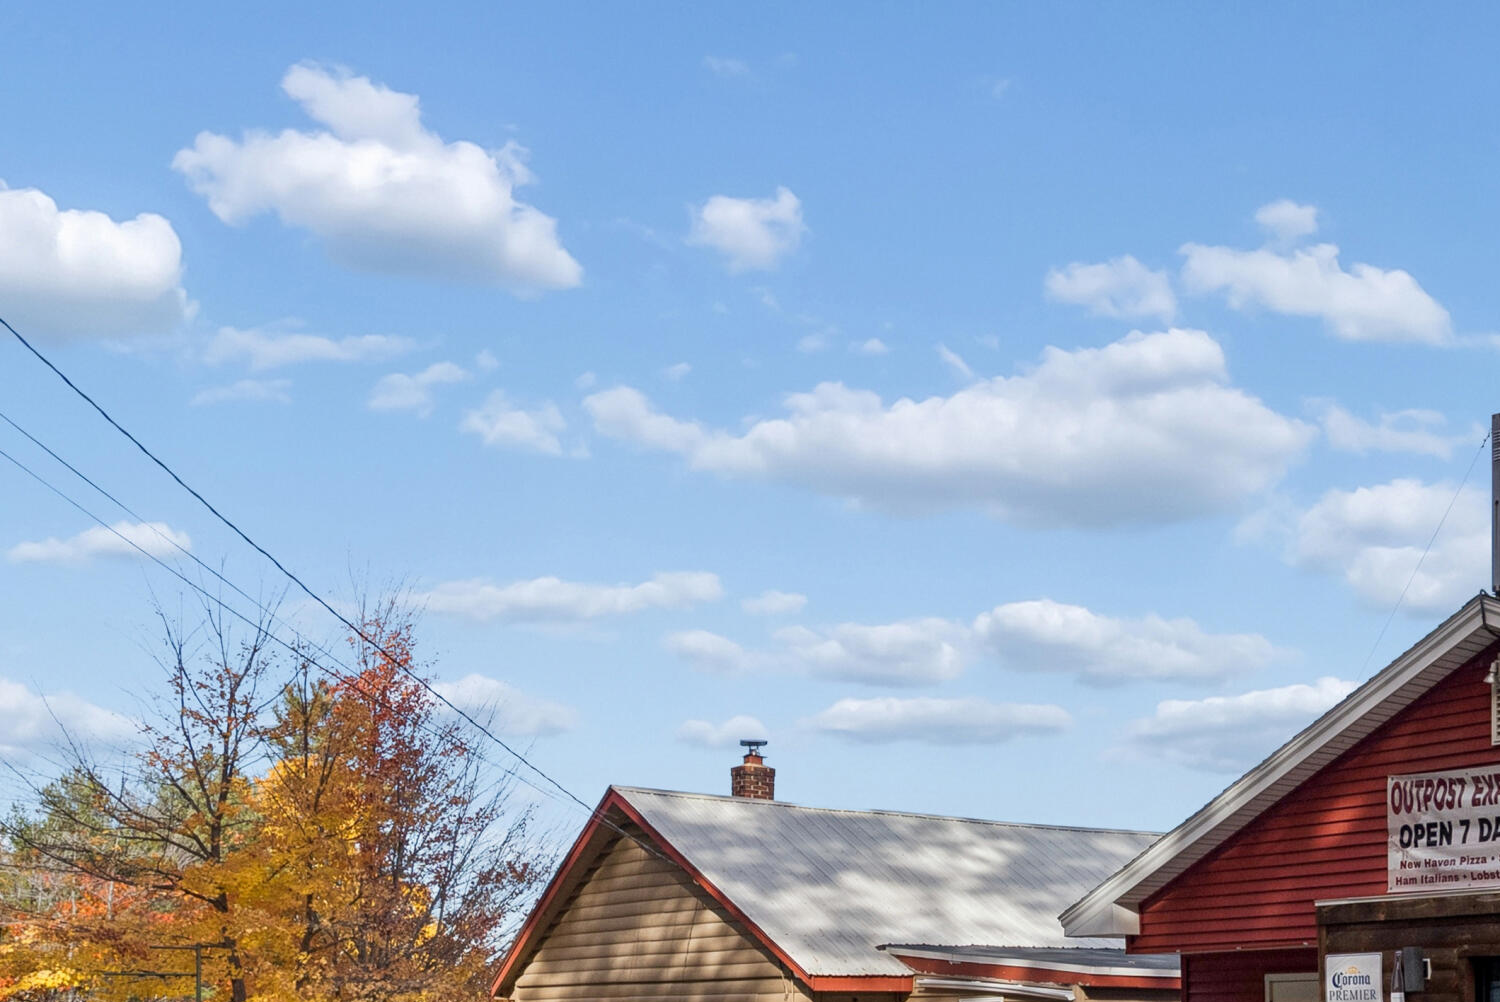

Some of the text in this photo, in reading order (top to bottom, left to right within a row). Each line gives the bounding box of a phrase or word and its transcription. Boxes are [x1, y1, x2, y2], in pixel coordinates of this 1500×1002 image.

[1391, 777, 1467, 815] OUTPOST
[1400, 821, 1453, 849] OPEN
[1459, 819, 1471, 844] 7
[1400, 860, 1422, 870] New
[1424, 857, 1456, 869] Haven
[1460, 854, 1487, 866] Pizza
[1395, 875, 1418, 886] Ham
[1420, 872, 1460, 884] Italians
[1332, 971, 1371, 990] Corona
[1329, 989, 1377, 1001] PREMIER
